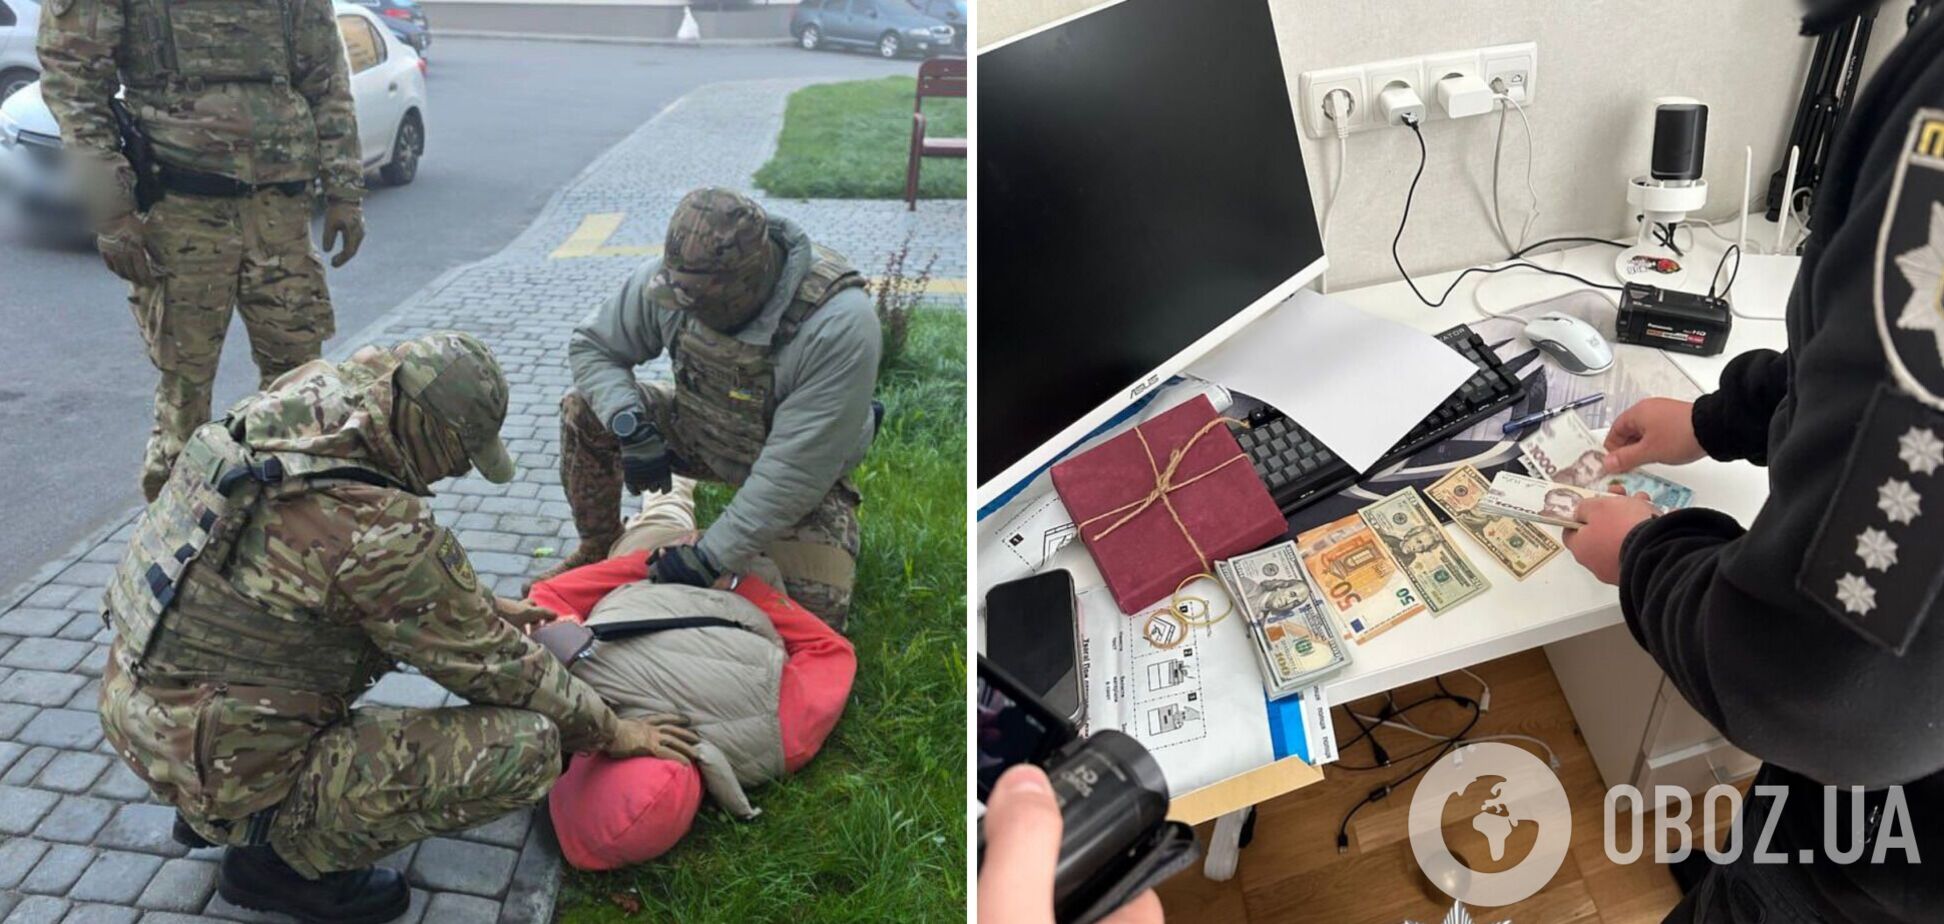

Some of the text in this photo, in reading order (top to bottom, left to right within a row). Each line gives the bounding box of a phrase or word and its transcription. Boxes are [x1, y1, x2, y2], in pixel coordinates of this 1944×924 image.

[1130, 374, 1159, 399] ASUS
[1330, 581, 1362, 612] 50
[1396, 588, 1415, 606] 50
